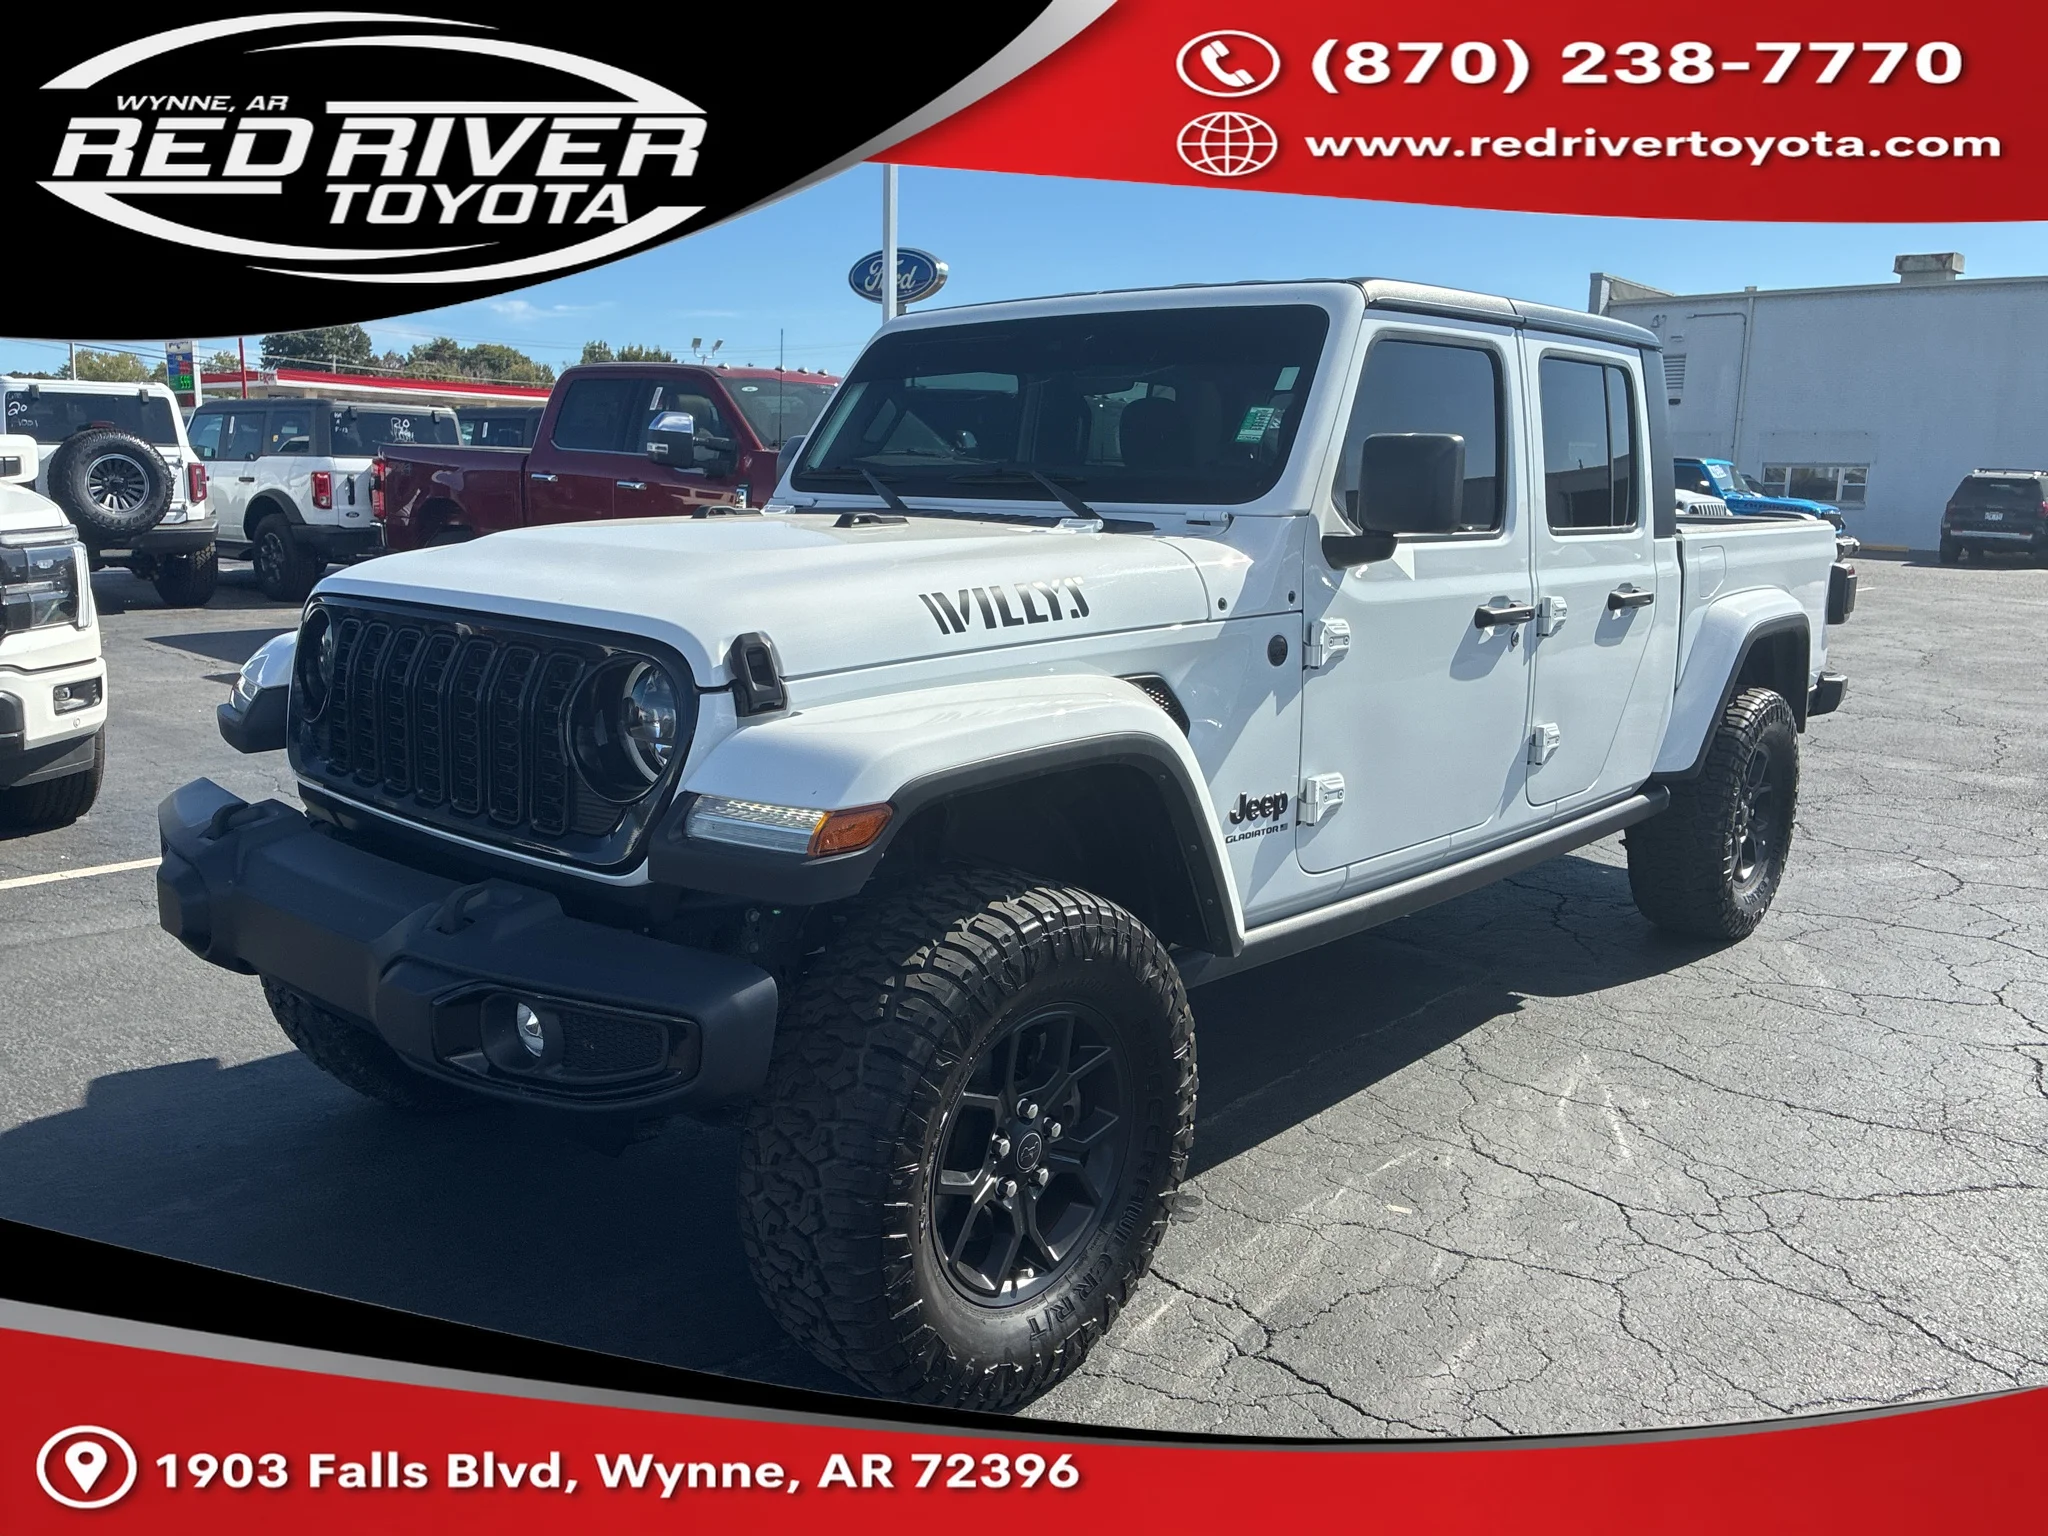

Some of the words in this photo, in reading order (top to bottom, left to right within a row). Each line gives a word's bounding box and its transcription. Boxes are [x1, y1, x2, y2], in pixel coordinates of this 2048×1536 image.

[864, 259, 918, 291] Fd
[918, 576, 1090, 635] WILLYS
[1229, 791, 1288, 824] Jeep
[1225, 825, 1279, 844] GLADIATOR
